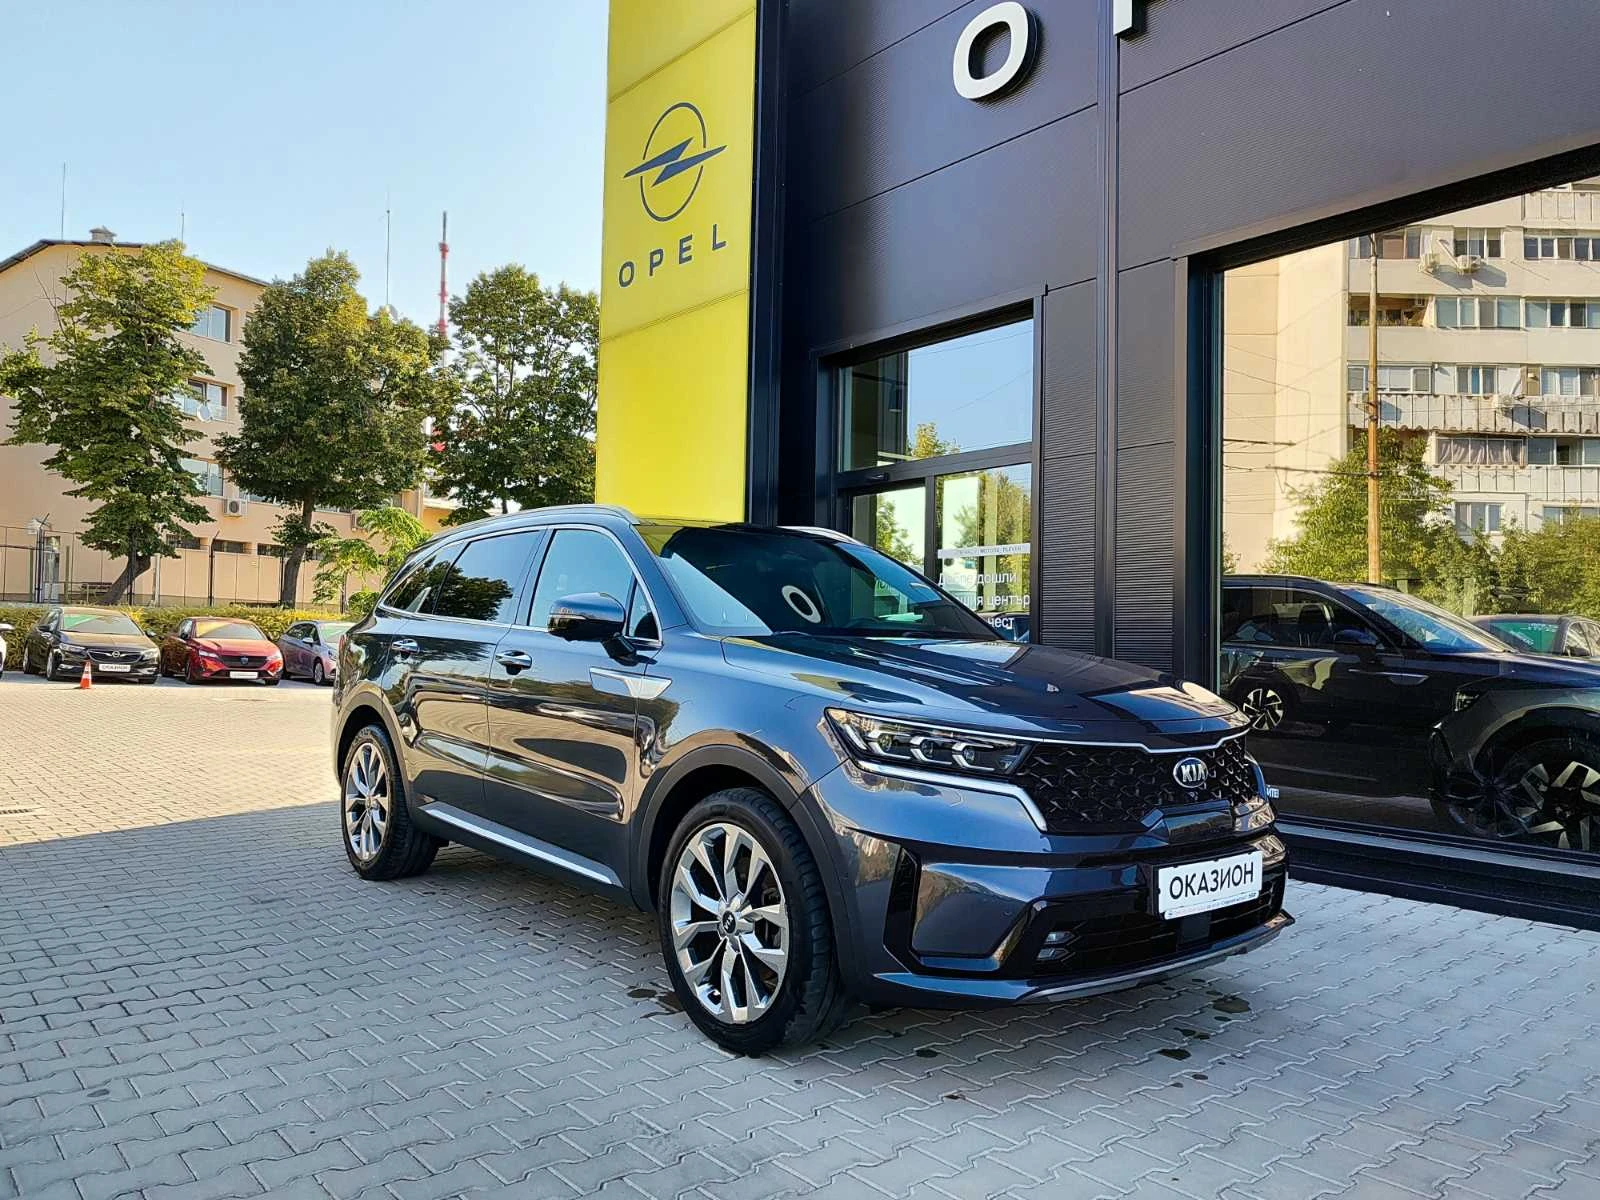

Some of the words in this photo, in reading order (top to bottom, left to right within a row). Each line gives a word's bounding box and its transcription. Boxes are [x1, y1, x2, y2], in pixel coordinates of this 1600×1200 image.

[618, 223, 727, 288] OPEL
[1180, 763, 1207, 783] KIA
[1169, 862, 1254, 899] ОКАЗИОН
